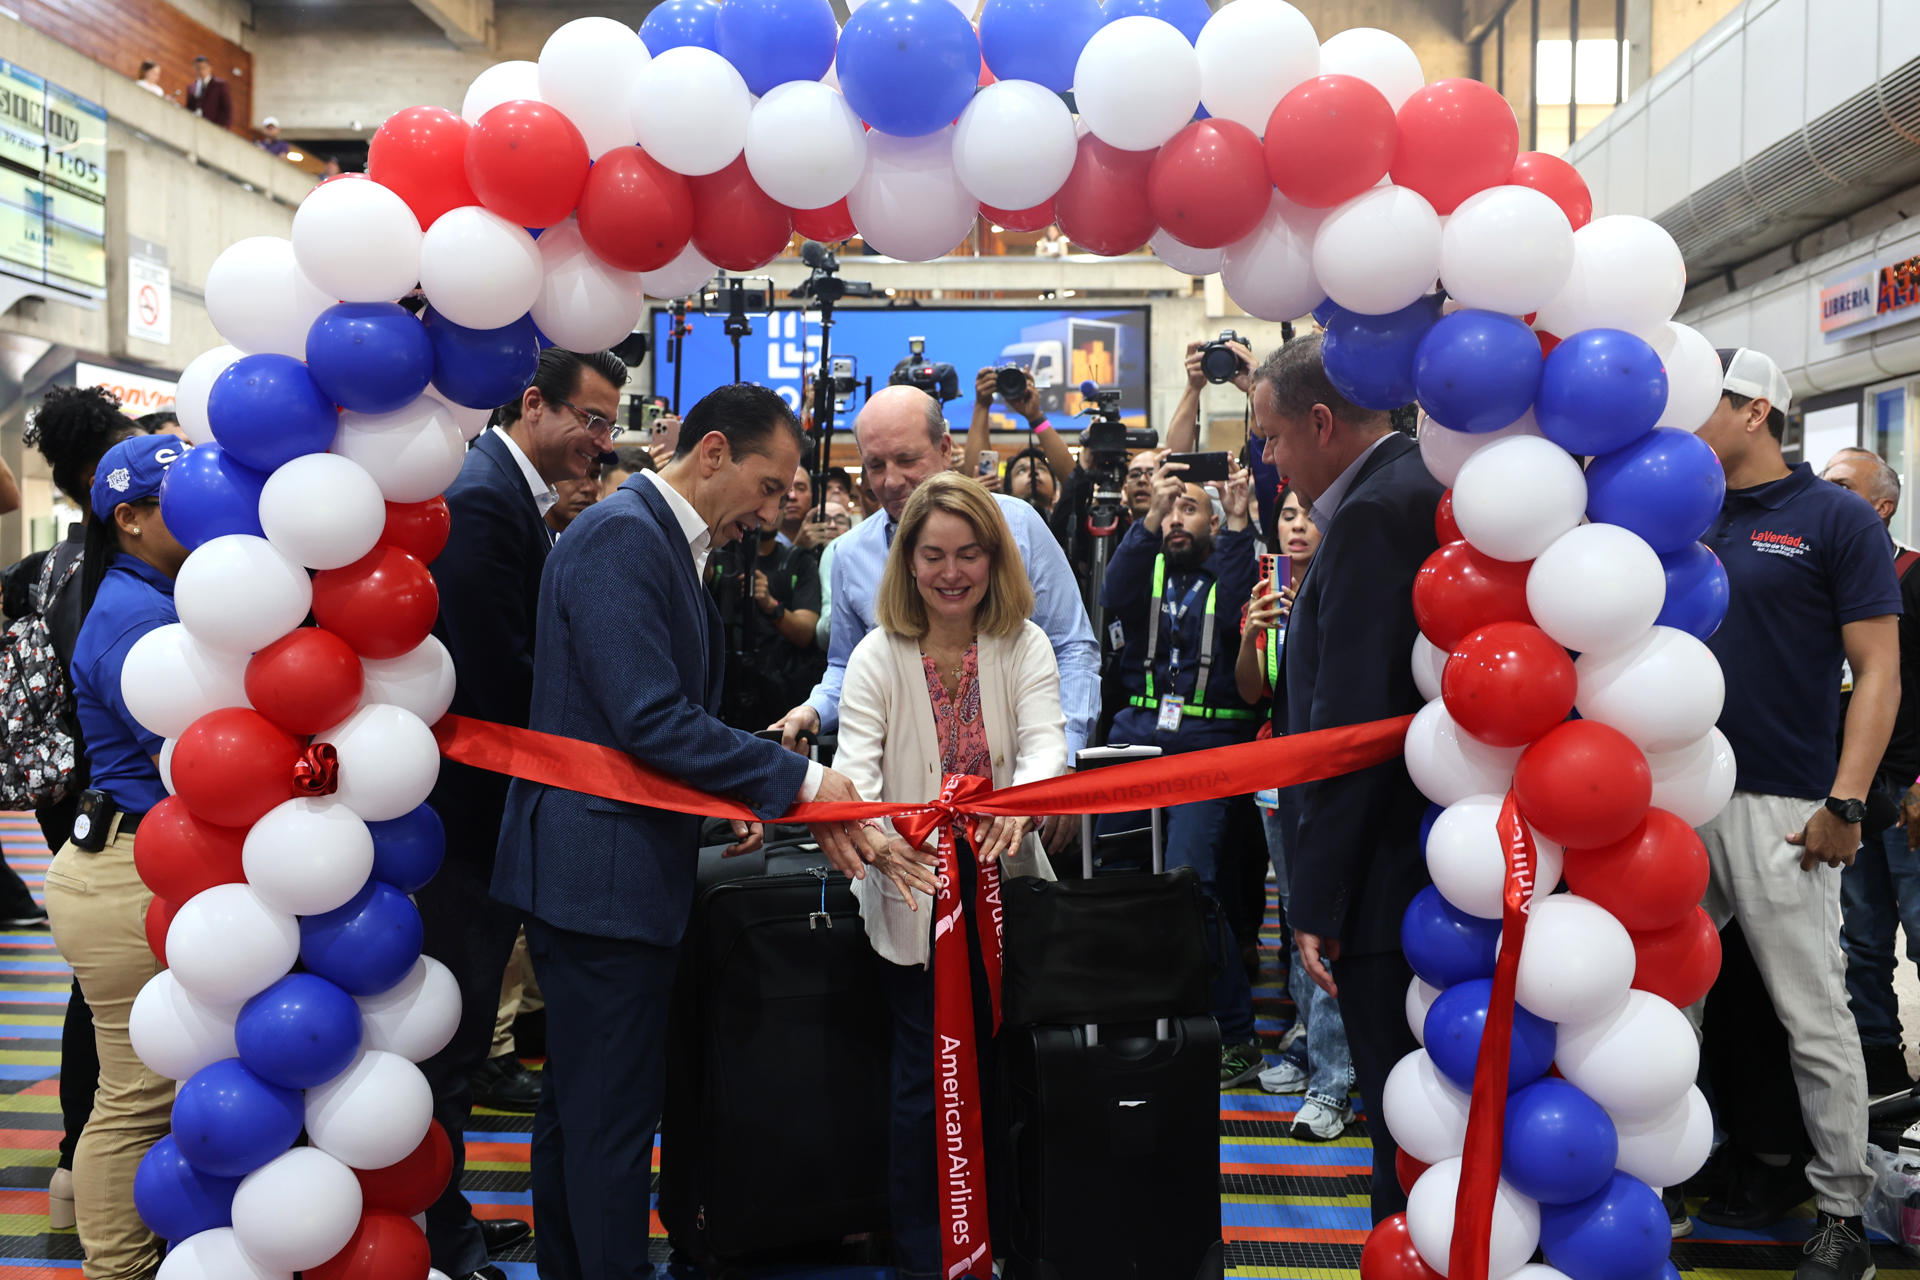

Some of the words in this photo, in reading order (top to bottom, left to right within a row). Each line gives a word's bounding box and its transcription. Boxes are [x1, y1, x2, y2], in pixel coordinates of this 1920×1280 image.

[42, 144, 99, 183] 11:05
[1824, 287, 1870, 318] LIBRERIA
[940, 1034, 973, 1245] AmericanAirlines
